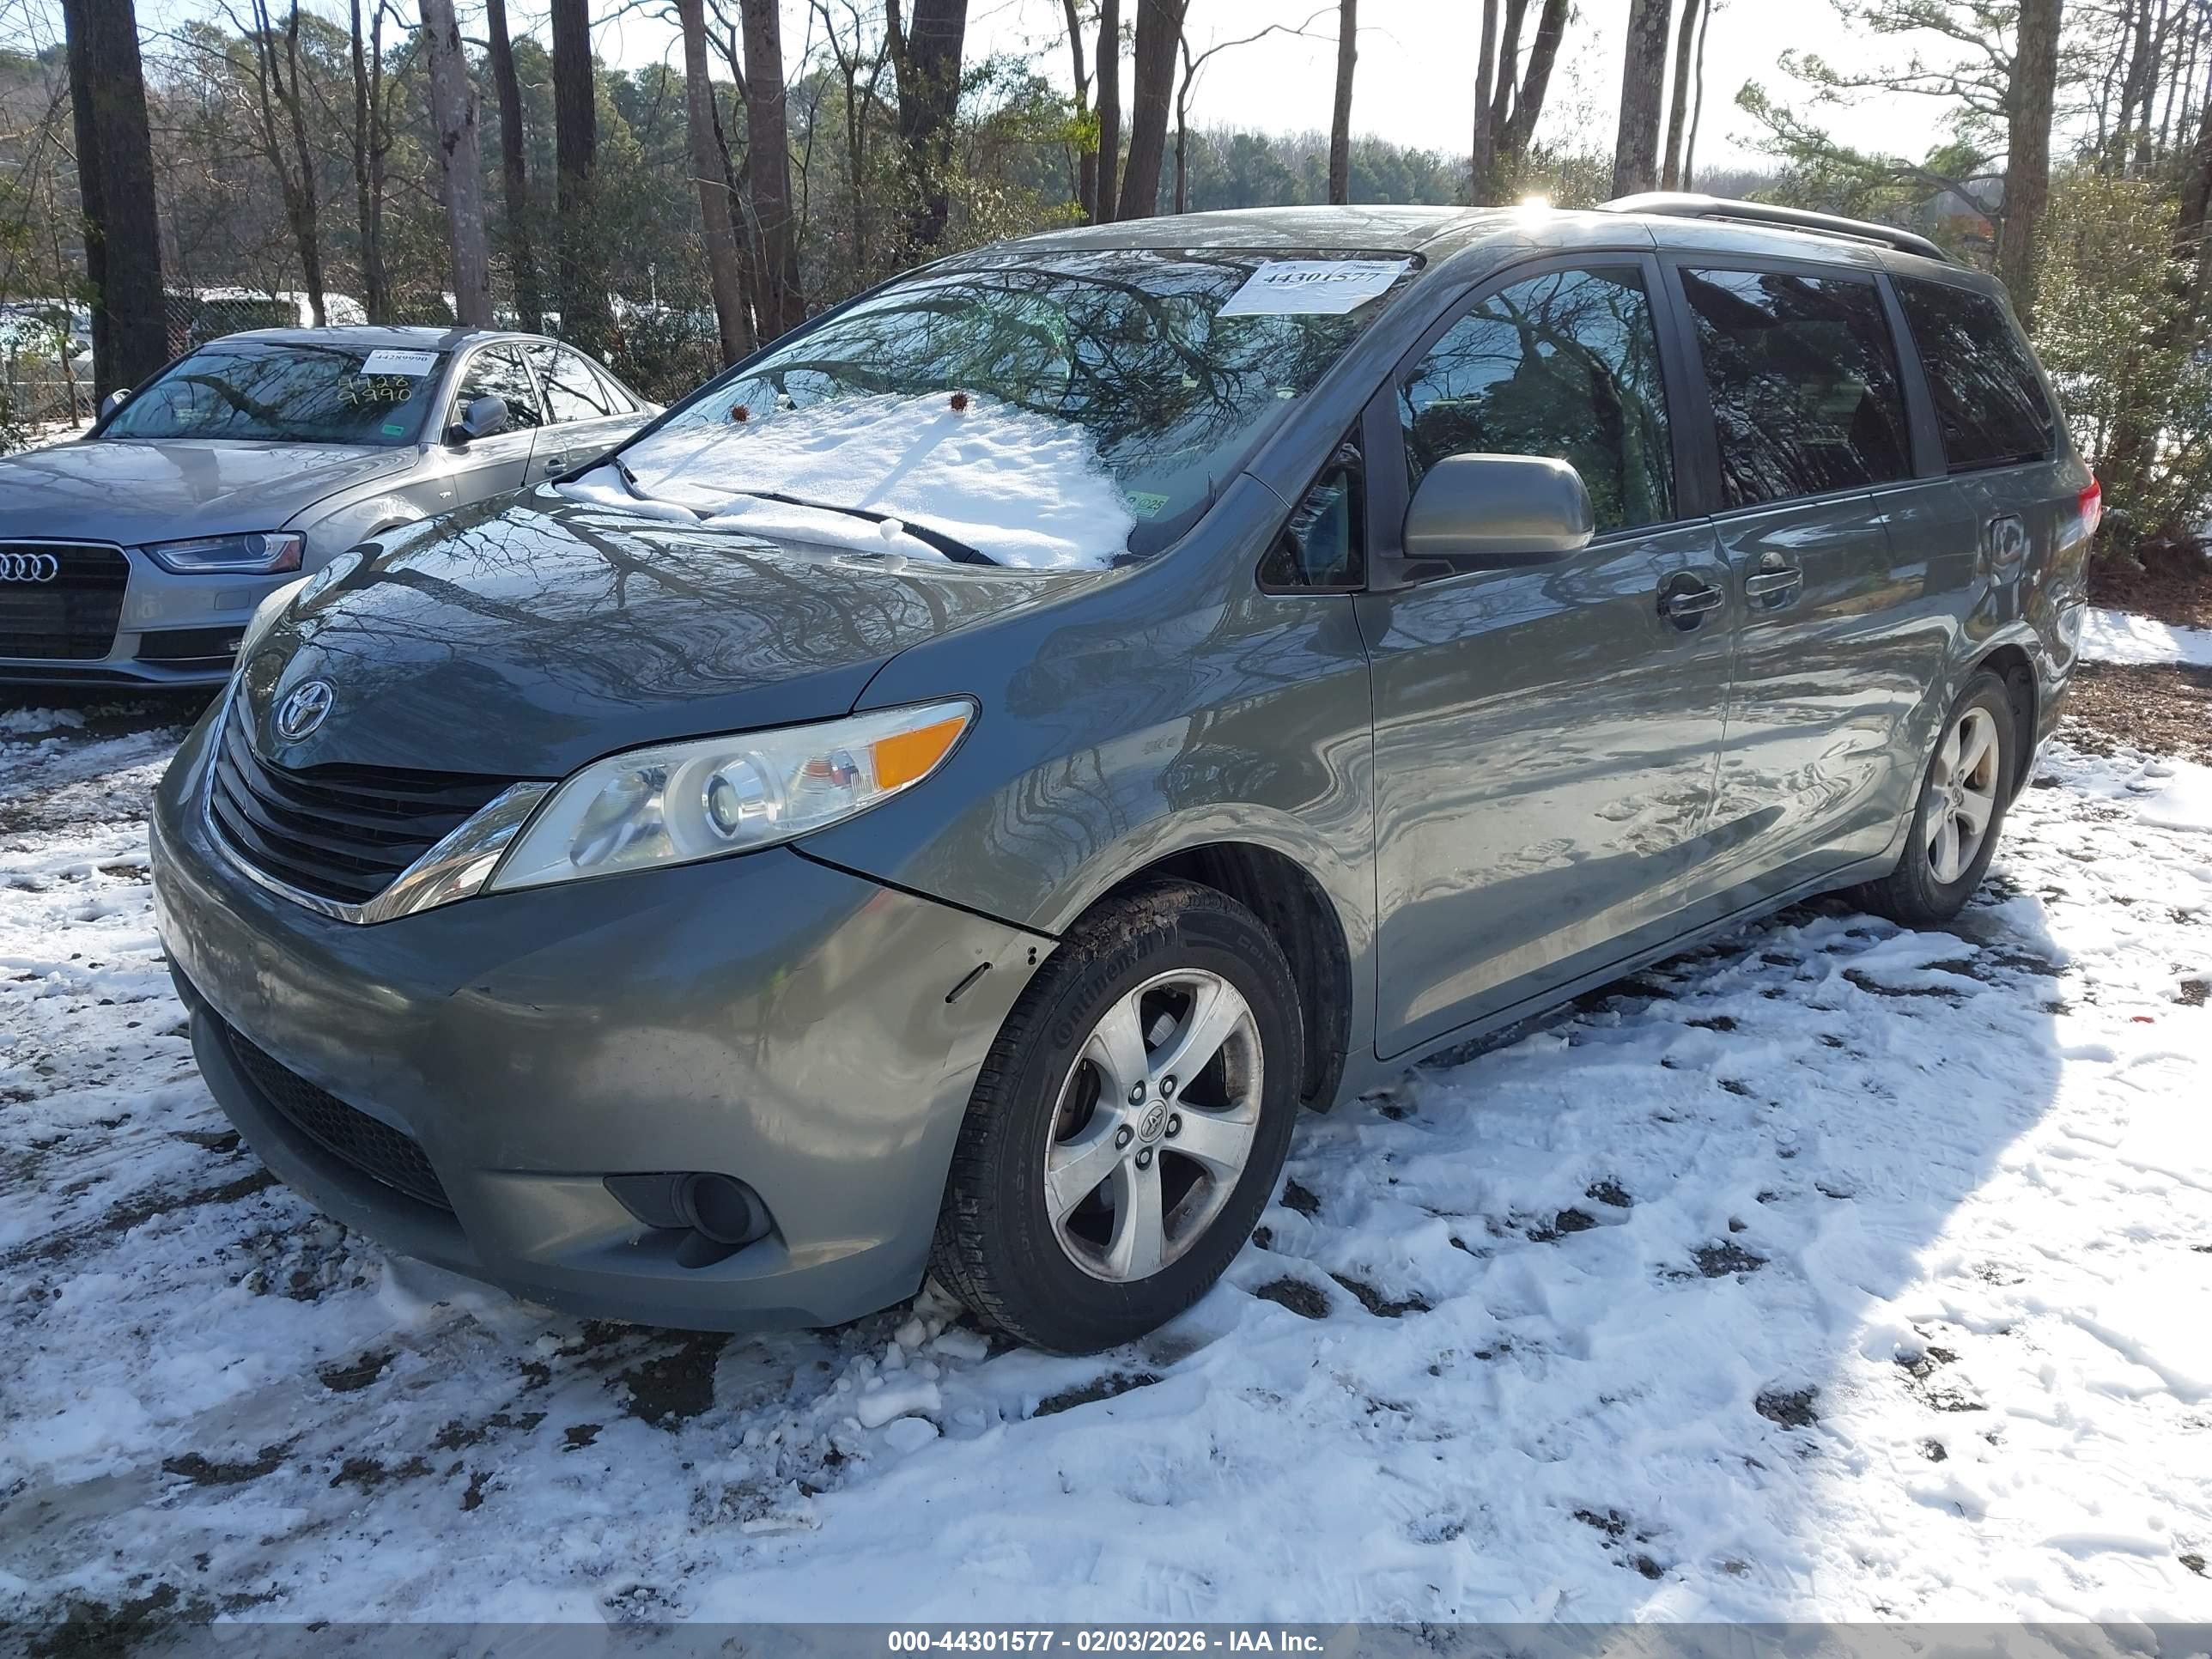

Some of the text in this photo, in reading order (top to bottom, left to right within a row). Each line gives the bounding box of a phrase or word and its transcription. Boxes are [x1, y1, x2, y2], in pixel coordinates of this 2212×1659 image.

[1263, 272, 1381, 283] 44301577
[337, 375, 409, 390] 4428
[337, 388, 412, 404] 9990
